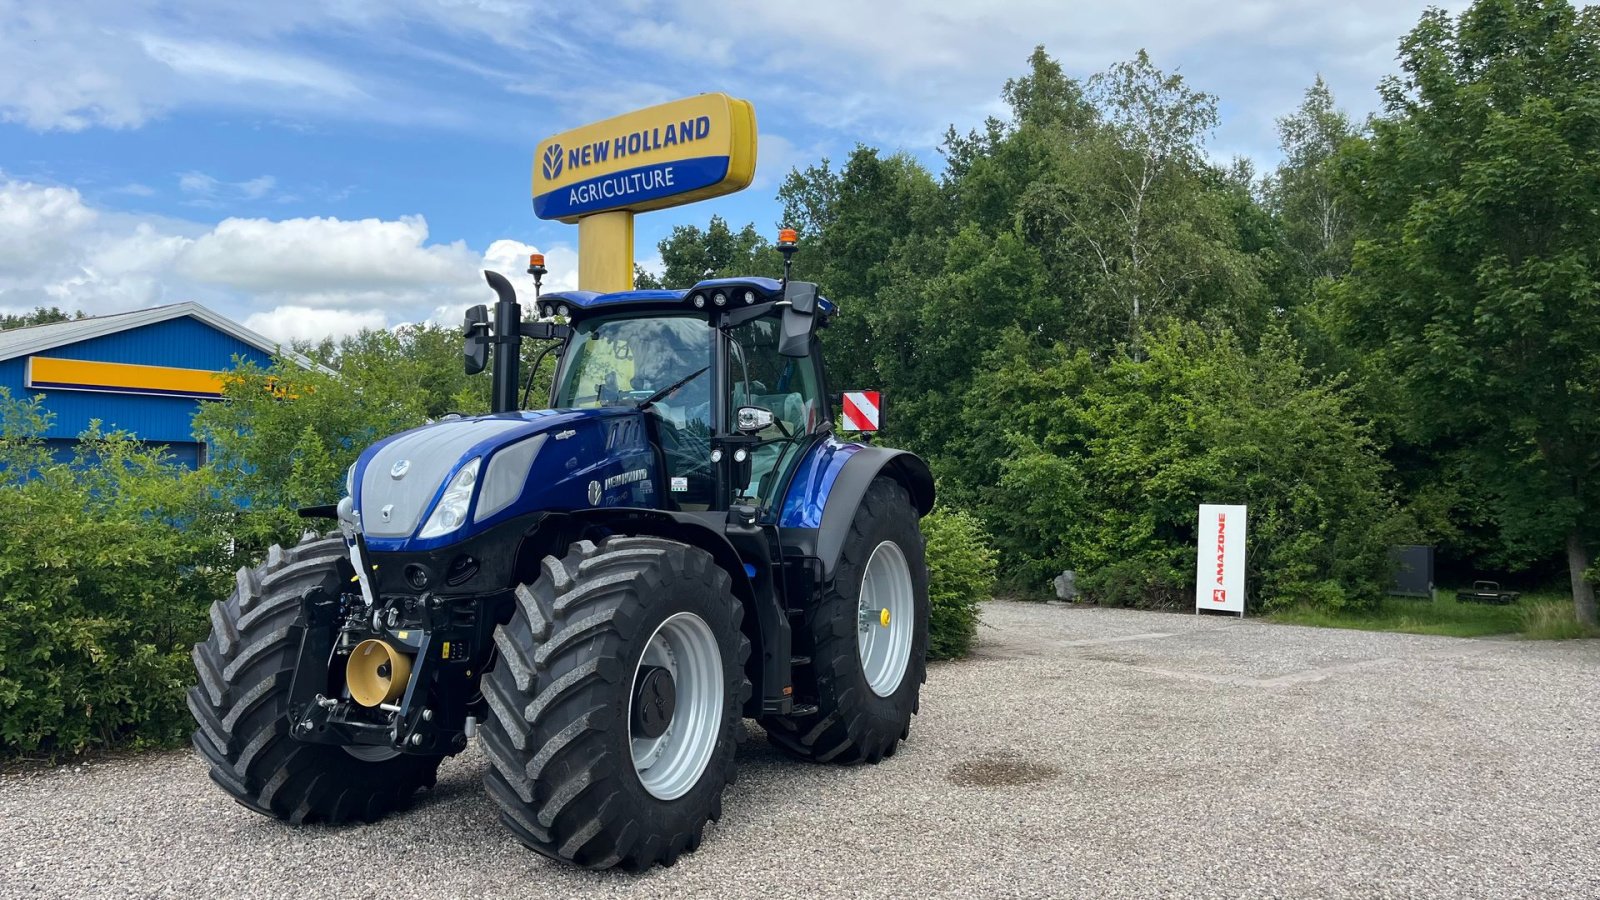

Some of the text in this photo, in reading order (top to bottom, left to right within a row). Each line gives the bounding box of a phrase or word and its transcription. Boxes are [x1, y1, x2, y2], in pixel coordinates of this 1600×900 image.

[568, 116, 710, 169] NEW HOLLAND
[569, 167, 675, 206] AGRICULTURE
[1216, 513, 1226, 585] AMAZONE
